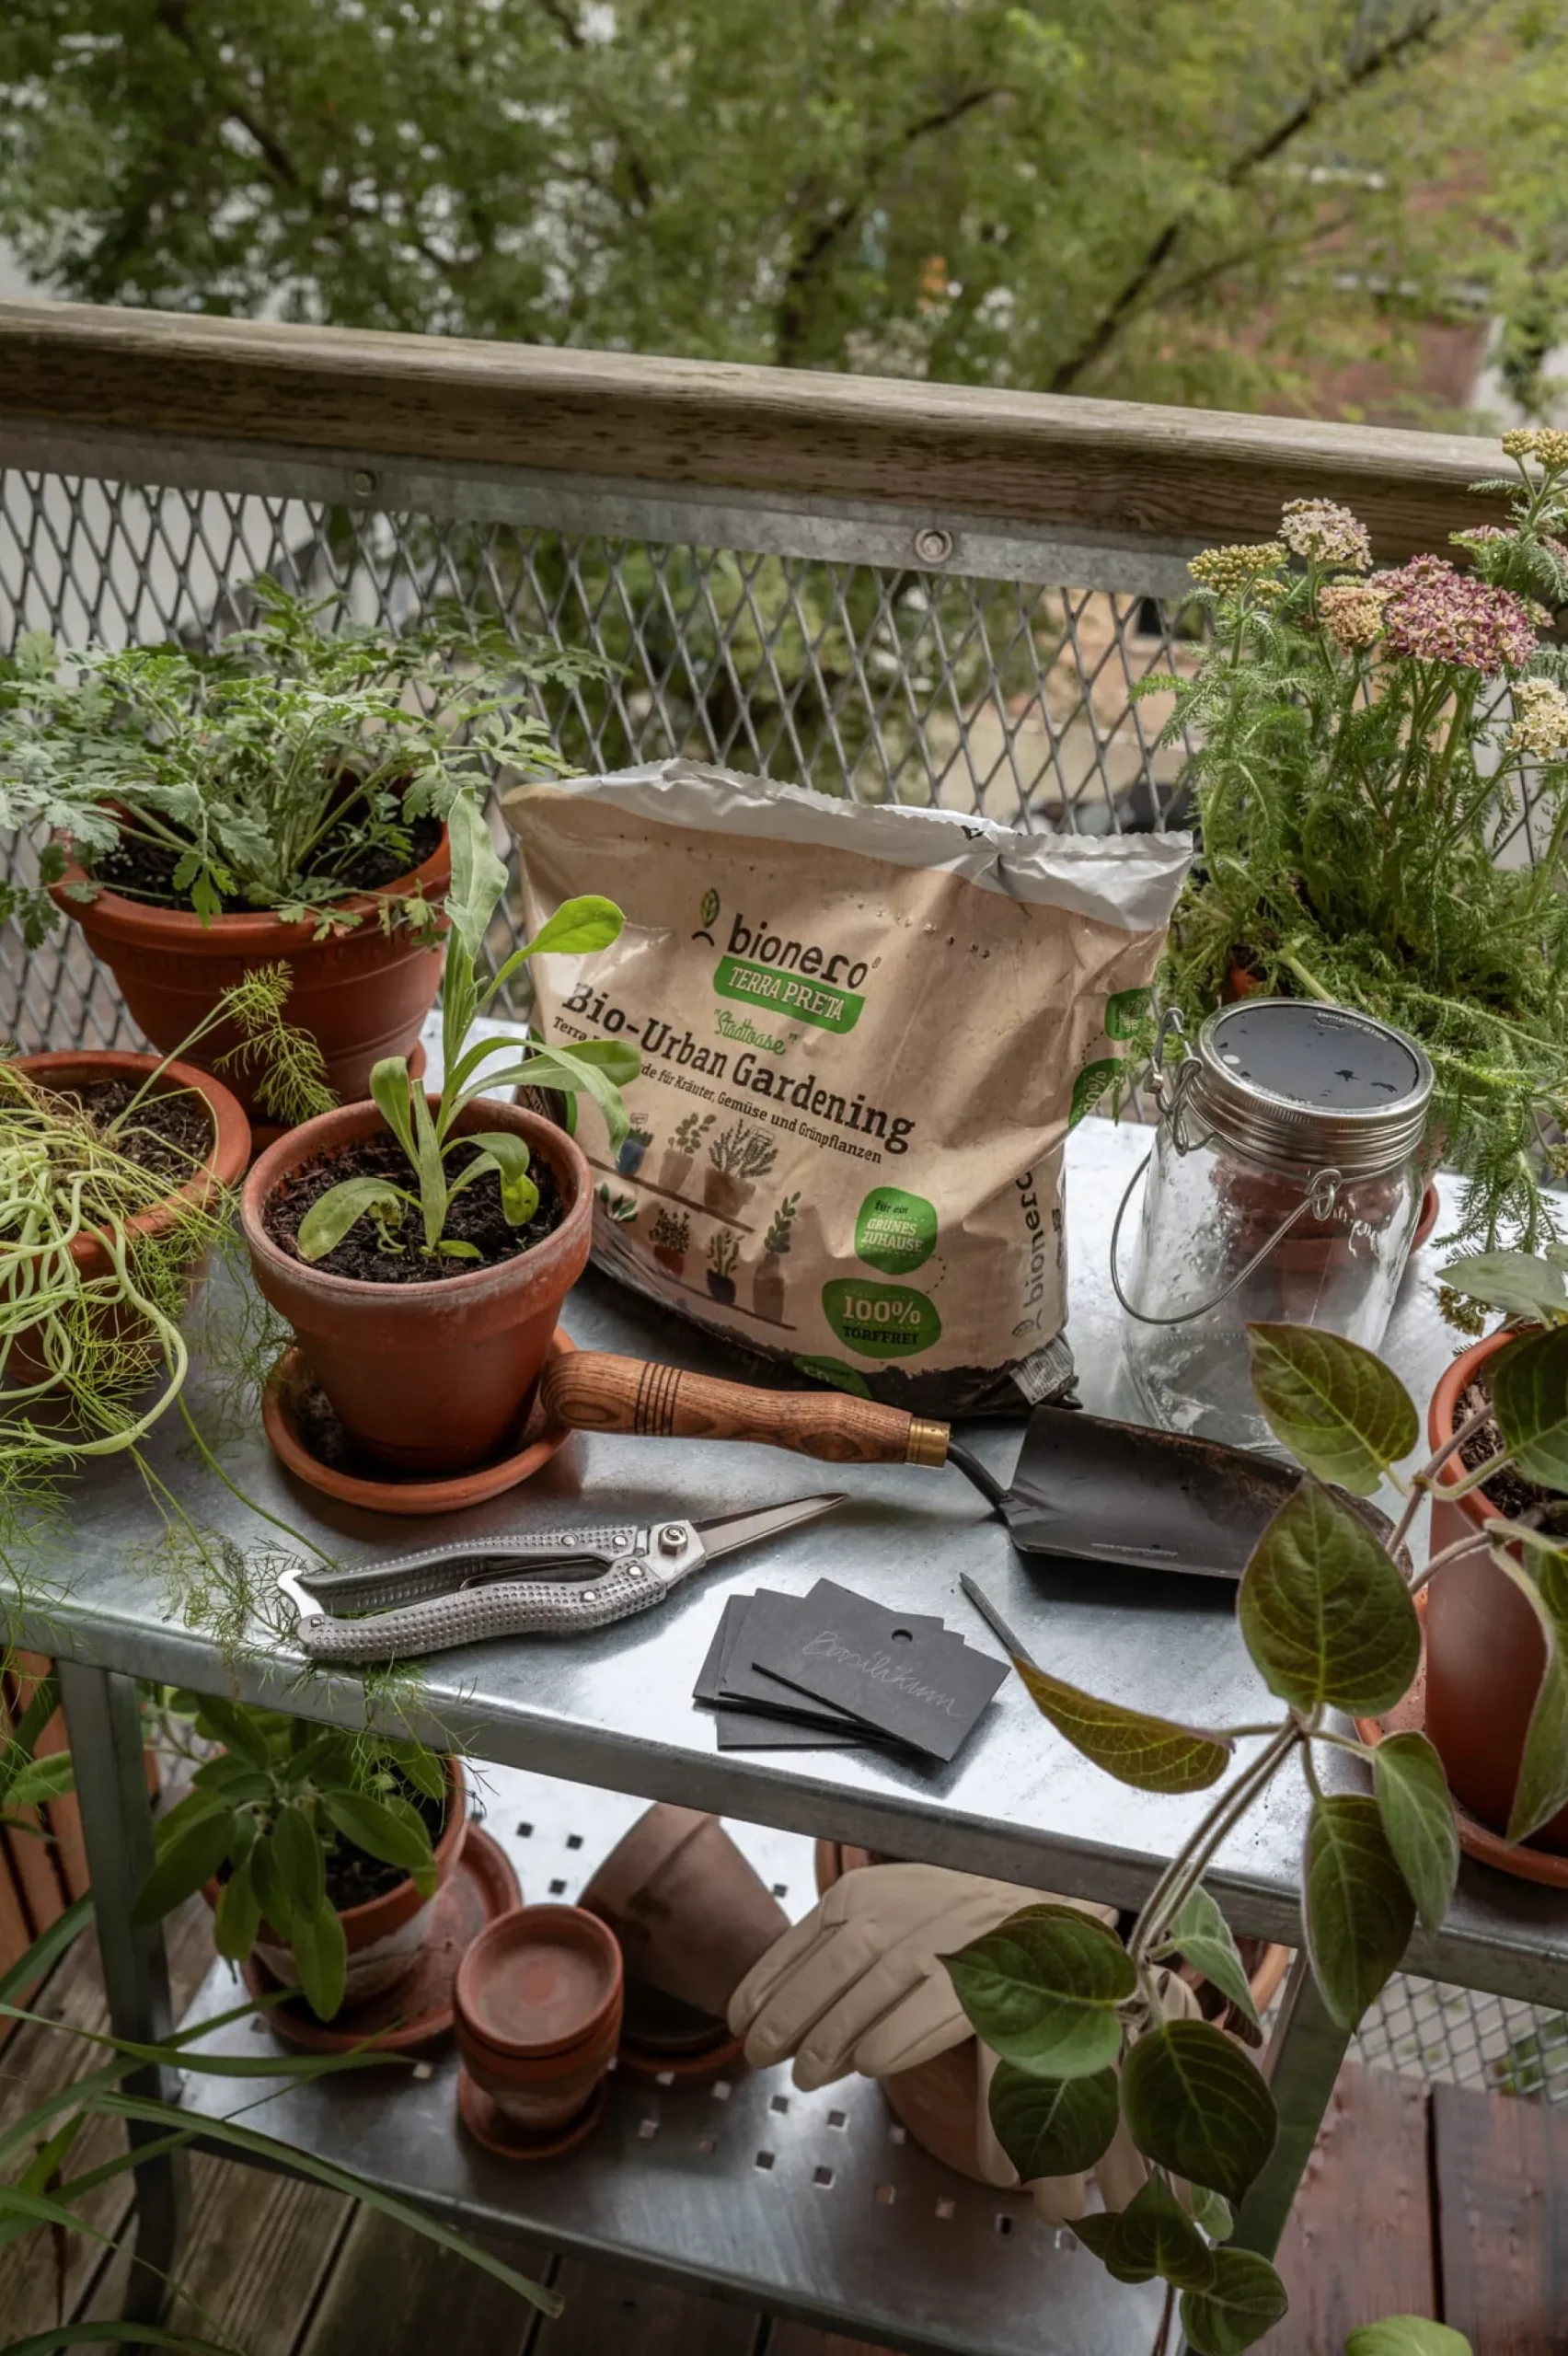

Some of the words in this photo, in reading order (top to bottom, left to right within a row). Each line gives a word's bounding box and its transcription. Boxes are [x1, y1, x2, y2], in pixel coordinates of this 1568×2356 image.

[728, 966, 782, 999] TERRA
[781, 981, 846, 1022] PRETA
[561, 982, 729, 1080] Bio-Urban
[732, 1052, 916, 1156] Gardening
[552, 1015, 588, 1042] Terra
[657, 1069, 676, 1086] für
[674, 1074, 716, 1103] Kräuter,
[717, 1091, 768, 1122] Gemüse
[770, 1114, 799, 1134] und
[798, 1122, 882, 1165] Grünpflanzen
[874, 1199, 891, 1213] für
[892, 1206, 908, 1216] ein
[860, 1230, 925, 1253] ZUHAUSE
[842, 1295, 921, 1325] 100%
[842, 1324, 920, 1345] TORFFREI
